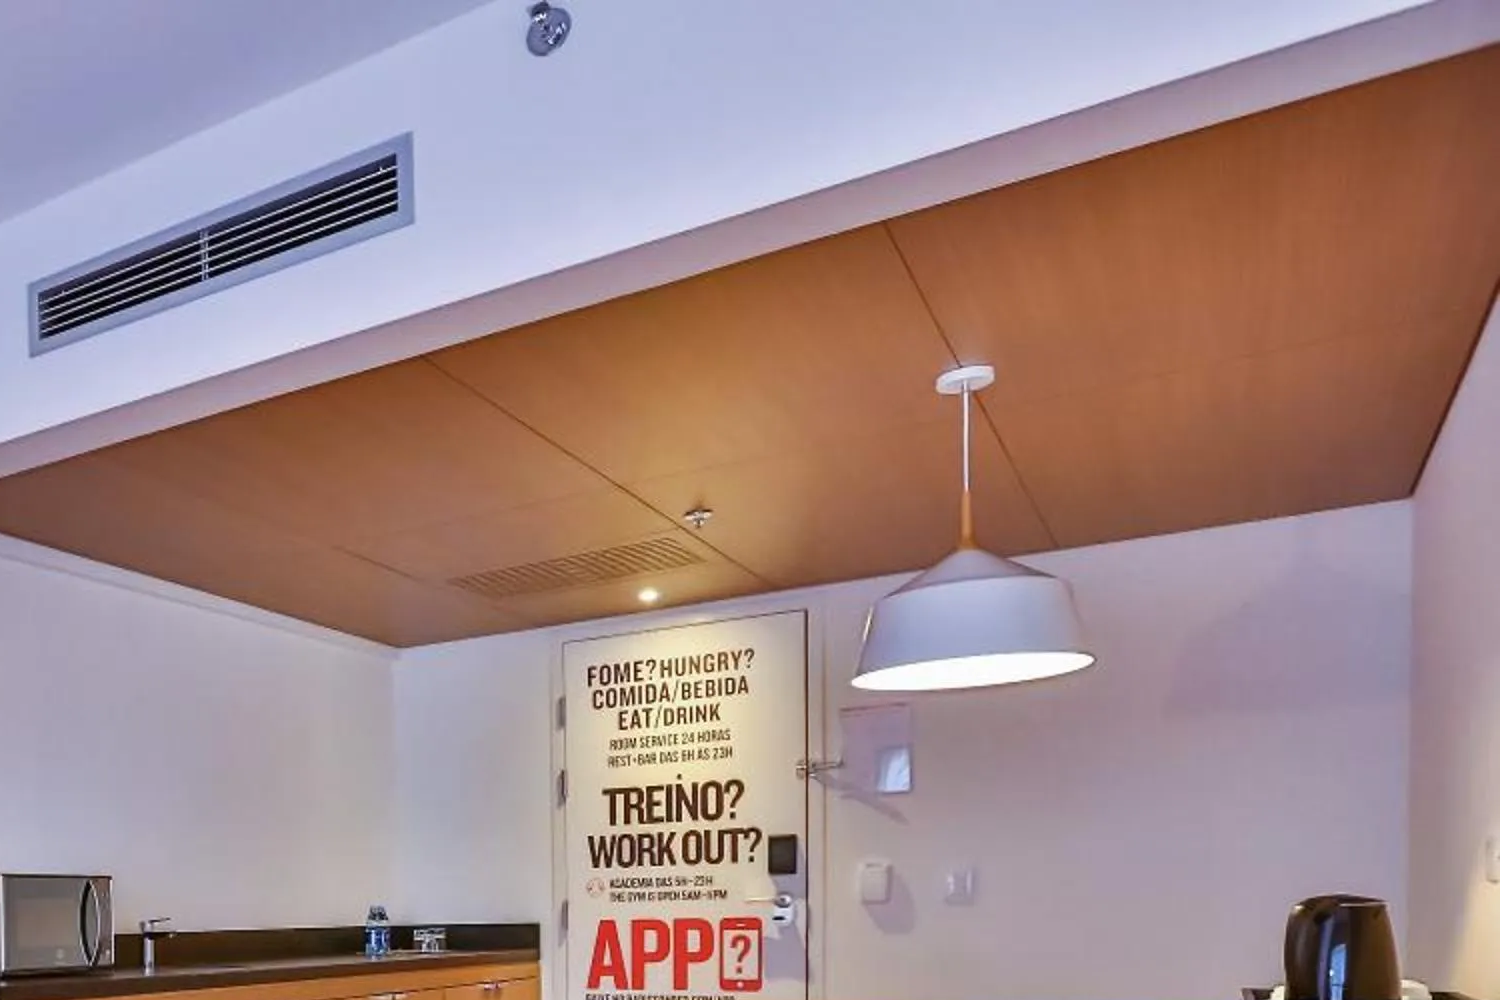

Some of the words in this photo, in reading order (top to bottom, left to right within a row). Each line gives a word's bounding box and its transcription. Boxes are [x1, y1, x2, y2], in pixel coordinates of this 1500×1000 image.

[587, 657, 657, 687] FOME?
[660, 648, 755, 678] HUNGRY?
[592, 675, 749, 710] COMIDA/BEBIDA
[618, 703, 721, 730] EAT/DRINK
[609, 737, 636, 750] ROOM
[640, 733, 678, 748] SERVICE
[681, 731, 695, 744] 24
[697, 728, 731, 743] HORAS
[660, 751, 679, 764] DAS
[602, 779, 745, 826] TREINO?
[588, 831, 676, 868] WORK
[681, 827, 762, 865] OUT?
[586, 917, 714, 990] APP
